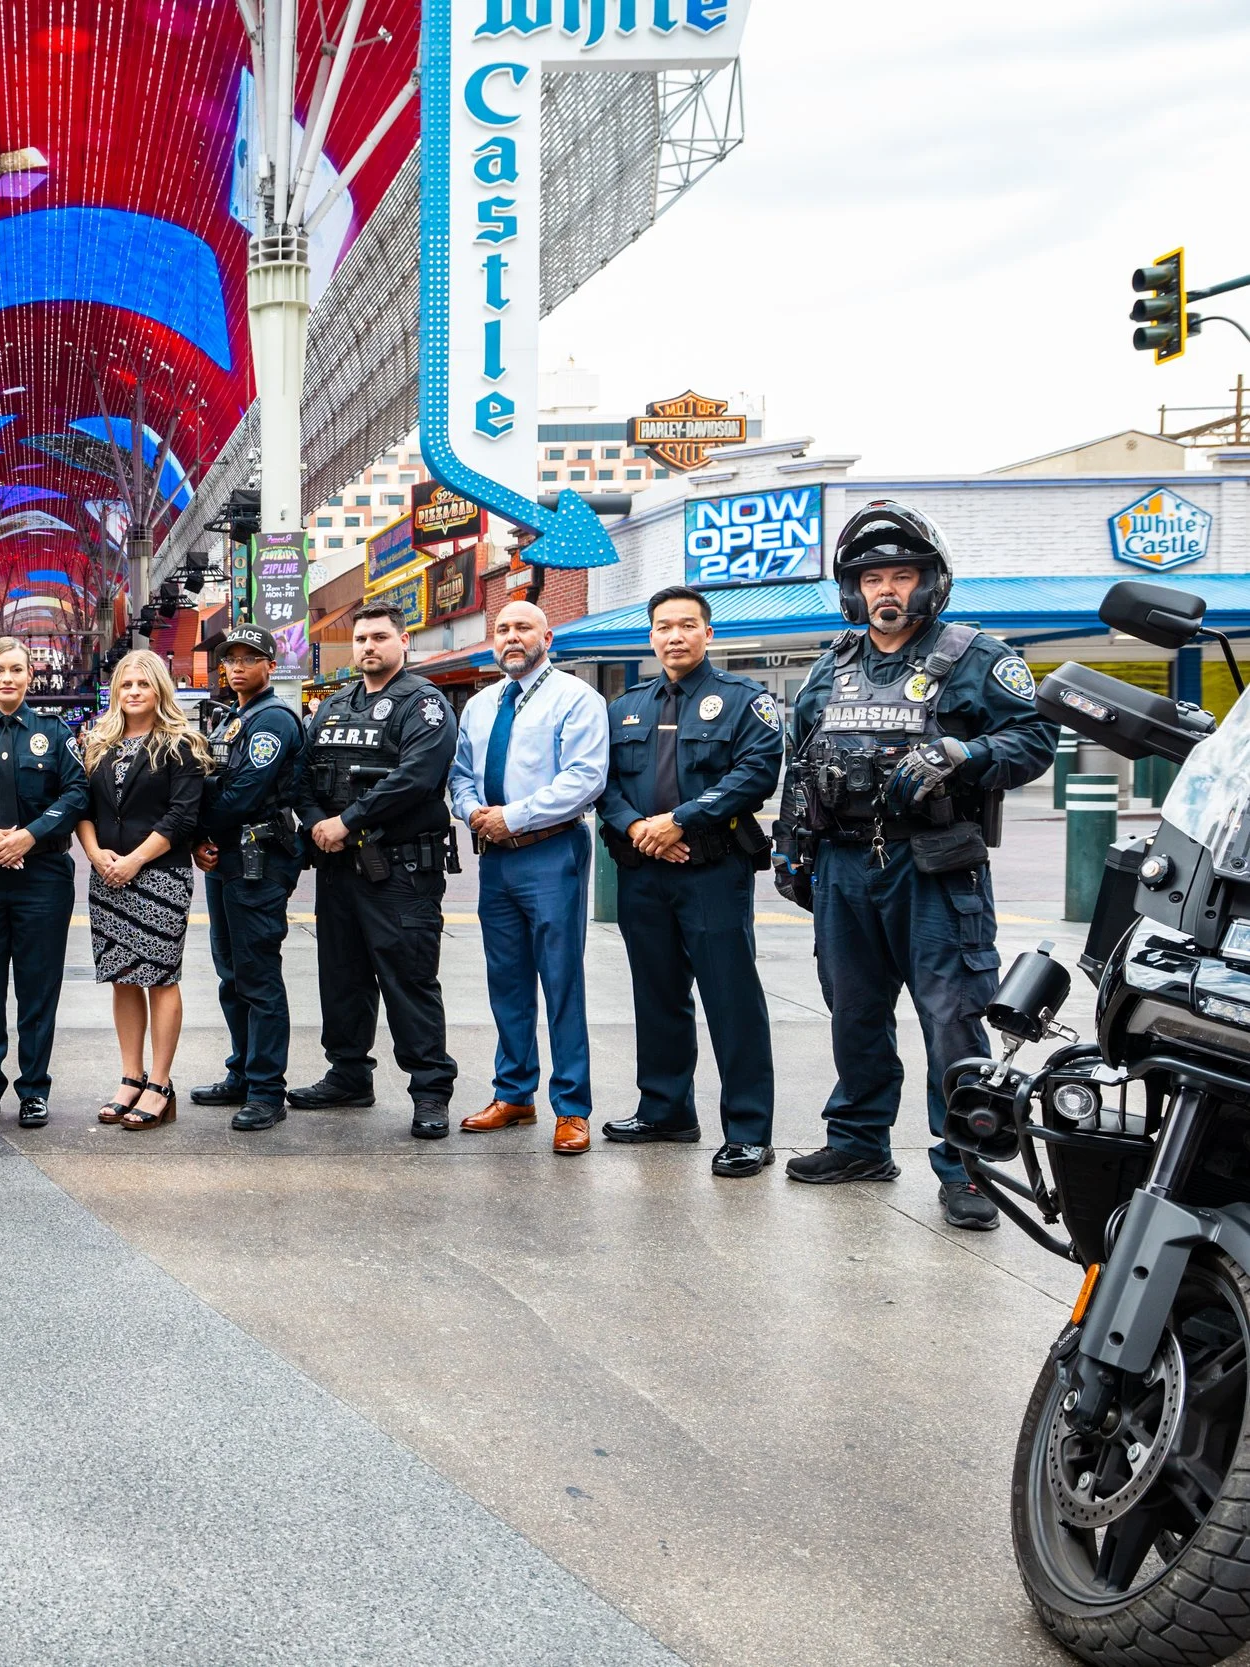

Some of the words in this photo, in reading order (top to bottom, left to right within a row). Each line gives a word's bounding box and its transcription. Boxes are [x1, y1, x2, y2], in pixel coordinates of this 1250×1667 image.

[464, 62, 530, 438] Castle
[665, 398, 716, 416] MOTOR
[640, 420, 740, 438] HARLEY-DAVIDSON
[664, 442, 716, 465] CYCLE
[418, 504, 450, 524] PIZZA
[697, 490, 811, 529] NOW
[1130, 515, 1196, 536] White
[688, 517, 819, 556] OPEN
[1125, 535, 1199, 555] Castle
[262, 562, 298, 575] ZIPLINE
[700, 547, 805, 583] 24/7
[262, 583, 280, 592] 12pm
[285, 583, 299, 591] 5pm
[265, 602, 293, 620] $34
[763, 651, 790, 667] 107
[825, 706, 923, 722] MARSHAL
[824, 720, 922, 731] POLICE
[318, 728, 379, 746] S.E.R.T.
